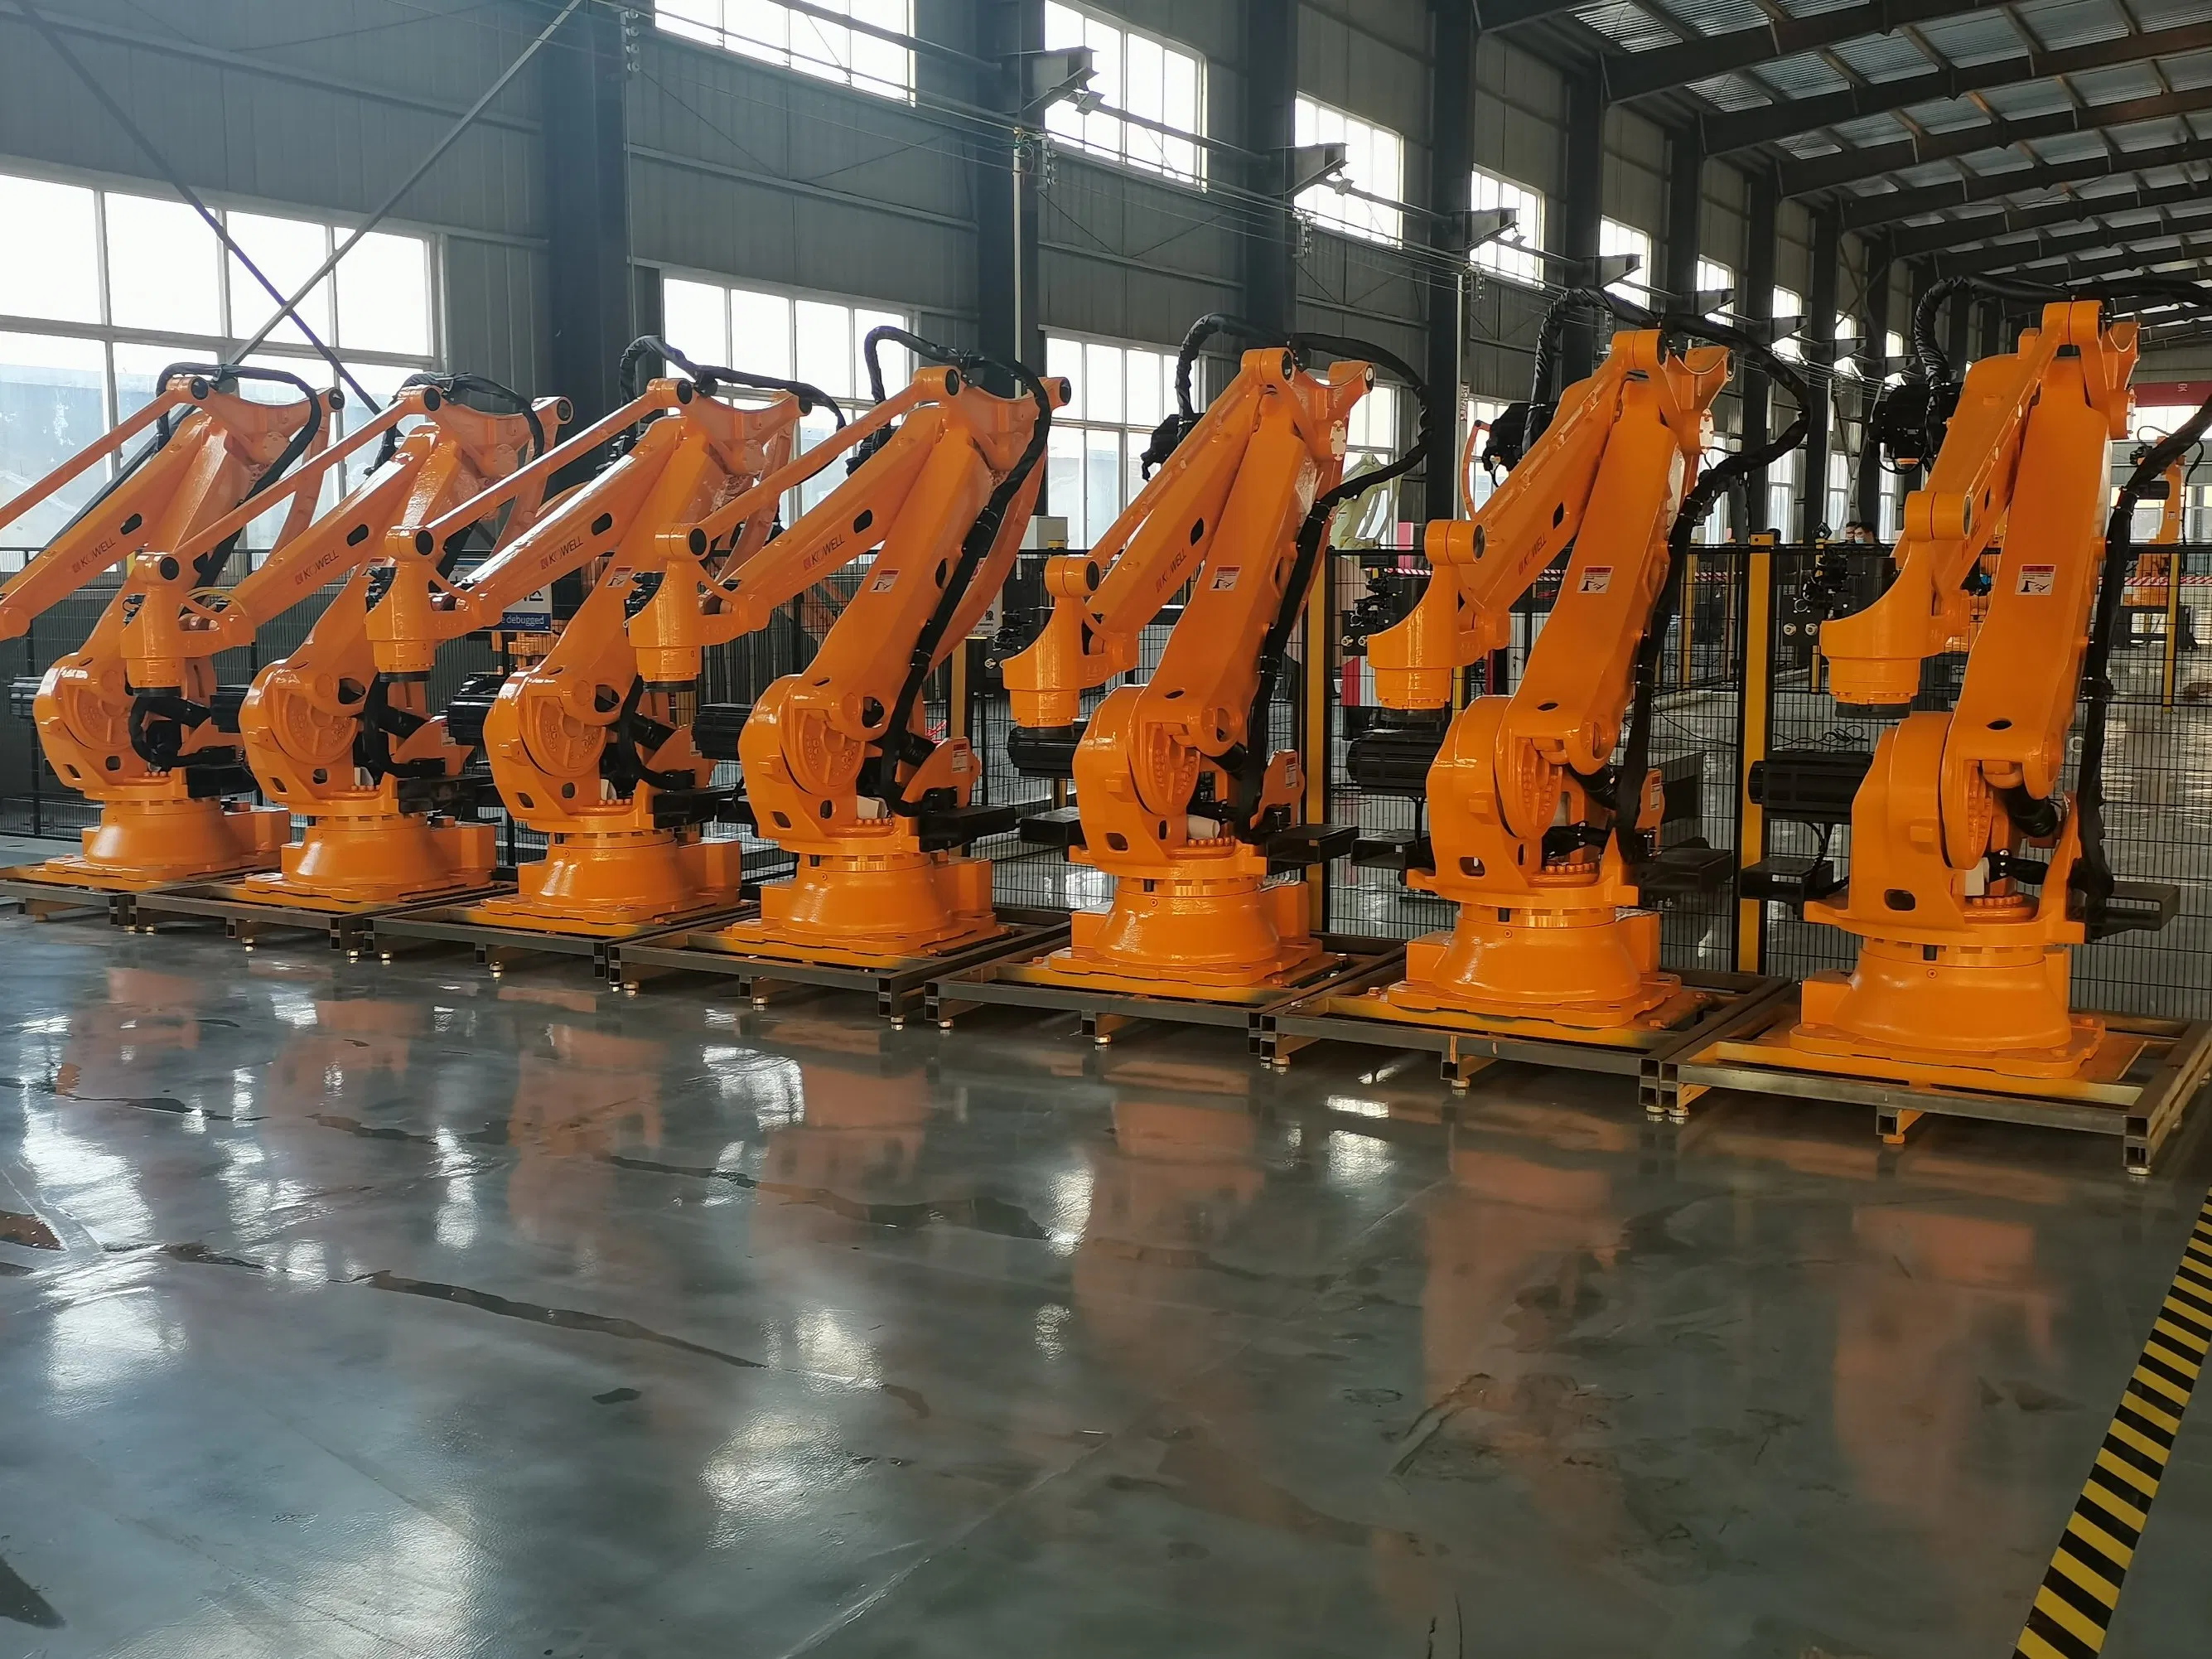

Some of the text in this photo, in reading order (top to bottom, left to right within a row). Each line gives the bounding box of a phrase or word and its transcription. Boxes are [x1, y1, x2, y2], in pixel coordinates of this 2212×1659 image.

[80, 537, 116, 568] KOWELL
[548, 536, 583, 564] KOWELL
[811, 534, 845, 565] KOWELL
[506, 616, 544, 626] debugged
